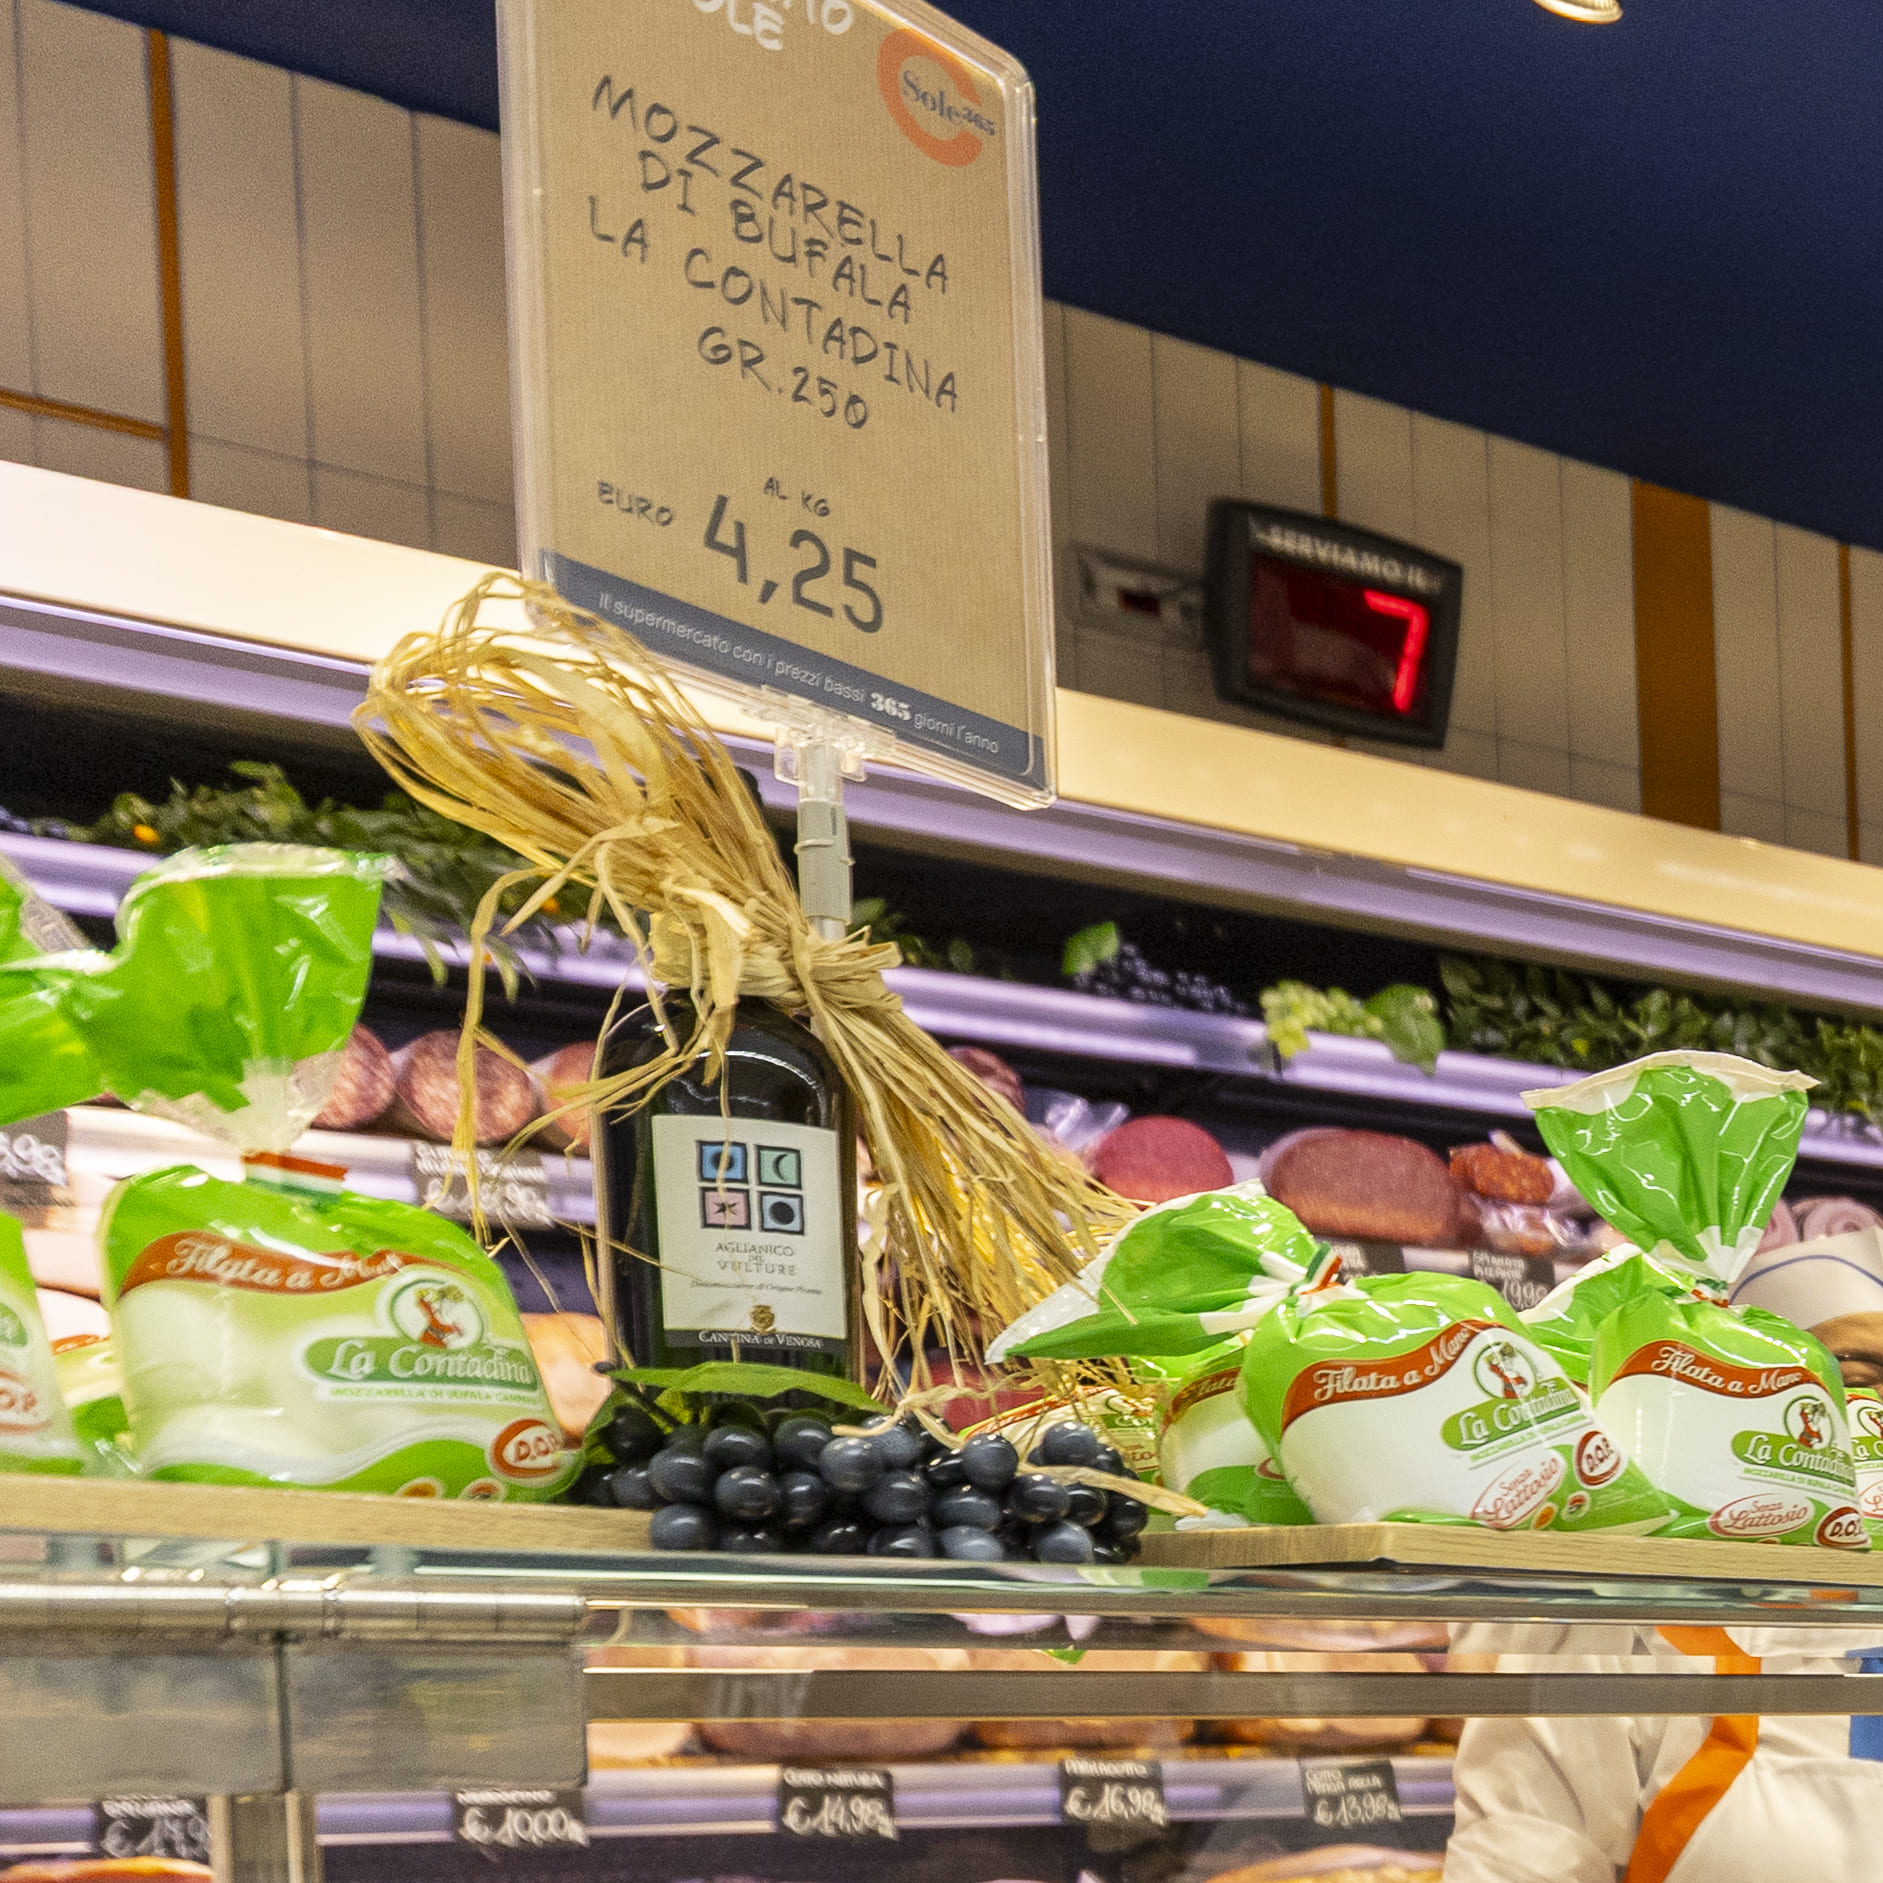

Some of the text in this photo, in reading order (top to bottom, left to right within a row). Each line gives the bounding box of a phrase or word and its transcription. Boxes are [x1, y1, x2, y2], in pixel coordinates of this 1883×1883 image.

[592, 73, 948, 294] MOZZARELLA
[639, 149, 912, 324] DI BUFALA
[588, 195, 958, 413] LA CONTADINA
[698, 326, 870, 430] GR.250
[597, 480, 884, 634] EURO 4,25
[614, 598, 730, 656] supermercato
[733, 646, 766, 669] con
[775, 660, 823, 688] prezzi
[824, 674, 864, 703] bassi
[870, 691, 911, 721] 365
[914, 709, 957, 739] giorni
[1363, 588, 1431, 714] 7
[167, 1236, 281, 1288] Filata
[715, 1241, 796, 1258] AGLIANICO
[716, 1260, 798, 1277] VULTURE
[326, 1340, 532, 1385] La Contadina
[1313, 1325, 1472, 1401] Filata a Mano
[1651, 1345, 1803, 1395] Filata a Mano
[1457, 1410, 1490, 1447] La
[1743, 1434, 1773, 1465] La
[1725, 1503, 1809, 1531] Lattosio
